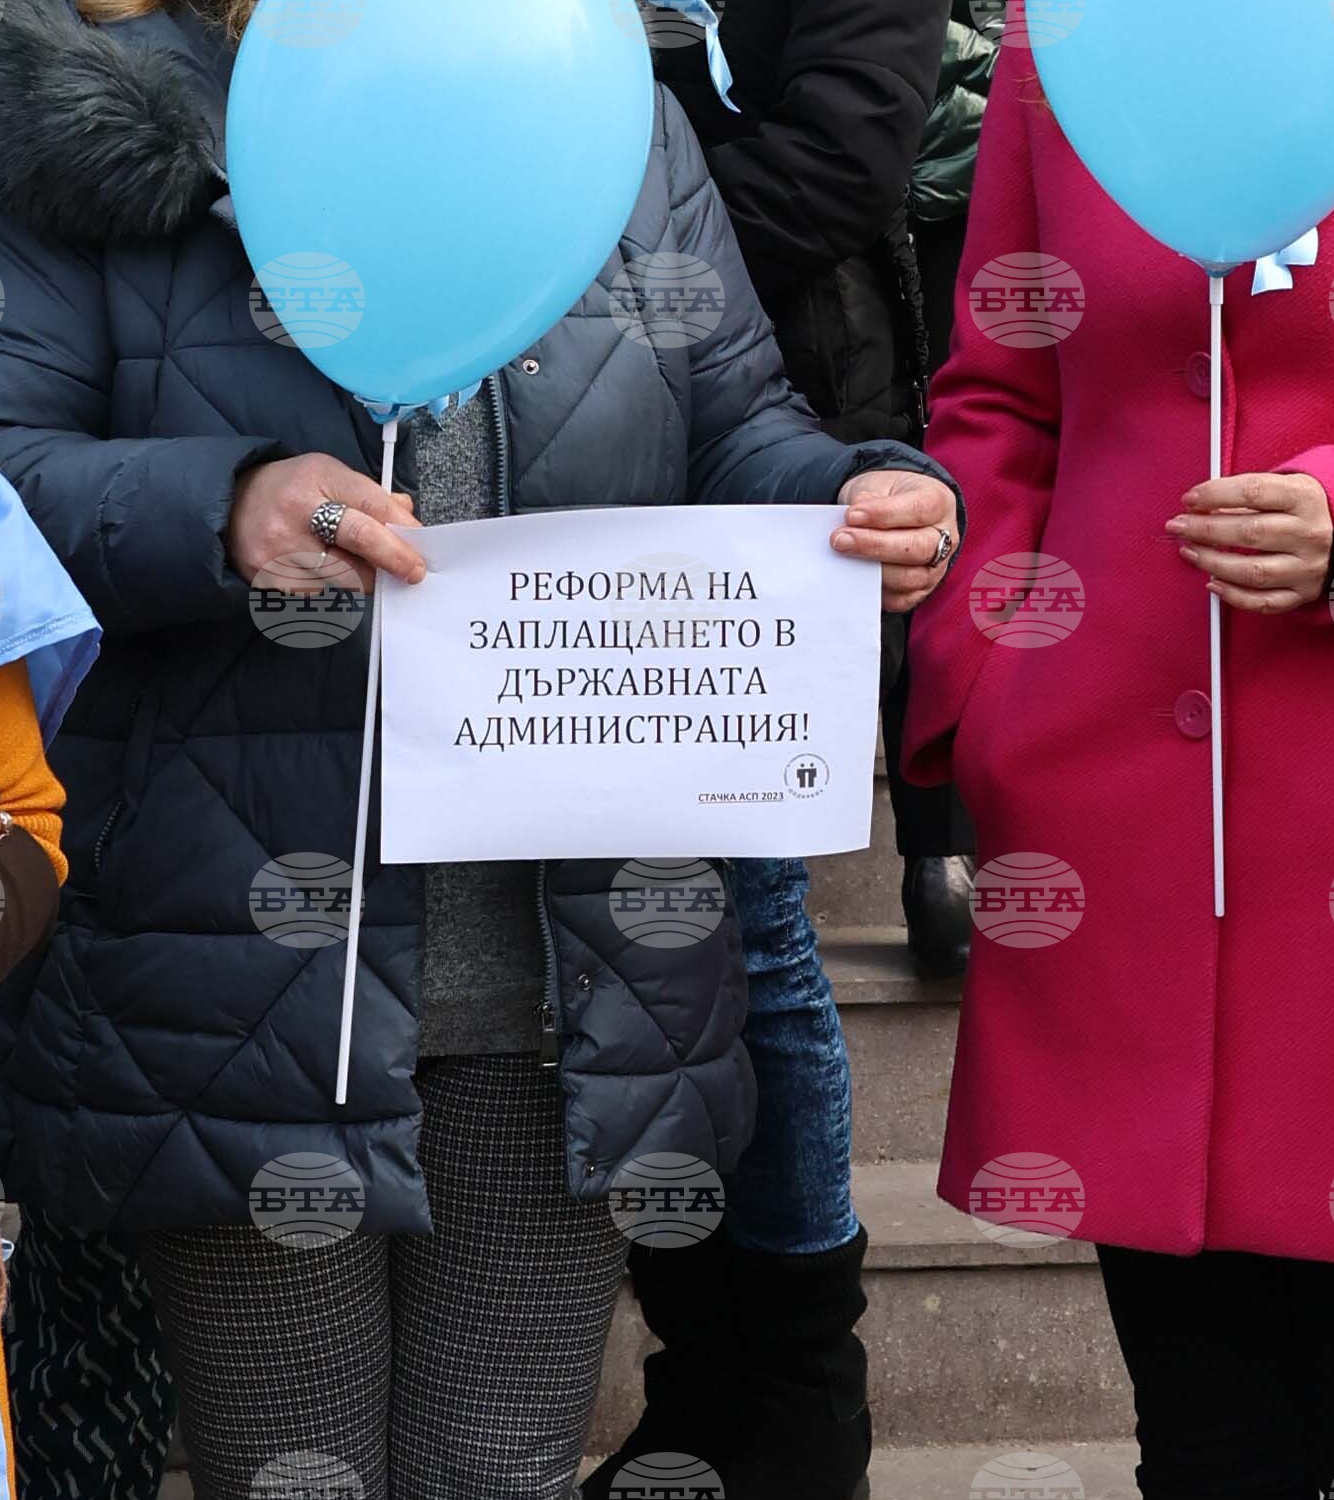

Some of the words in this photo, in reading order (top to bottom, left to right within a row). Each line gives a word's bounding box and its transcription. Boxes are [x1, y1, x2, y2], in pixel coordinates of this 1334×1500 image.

[509, 570, 694, 602] РЕФОРМА
[706, 570, 758, 602] НА
[469, 617, 762, 654] ЗАПЛАЩАНЕТО
[774, 618, 797, 648] В
[497, 666, 768, 704] ДЪРЖАВНАТА
[454, 713, 810, 751] АДМИНИСТРАЦИЯ!
[698, 791, 736, 804] СТАЧКА
[737, 791, 759, 802] АСП
[760, 790, 785, 802] 2023
